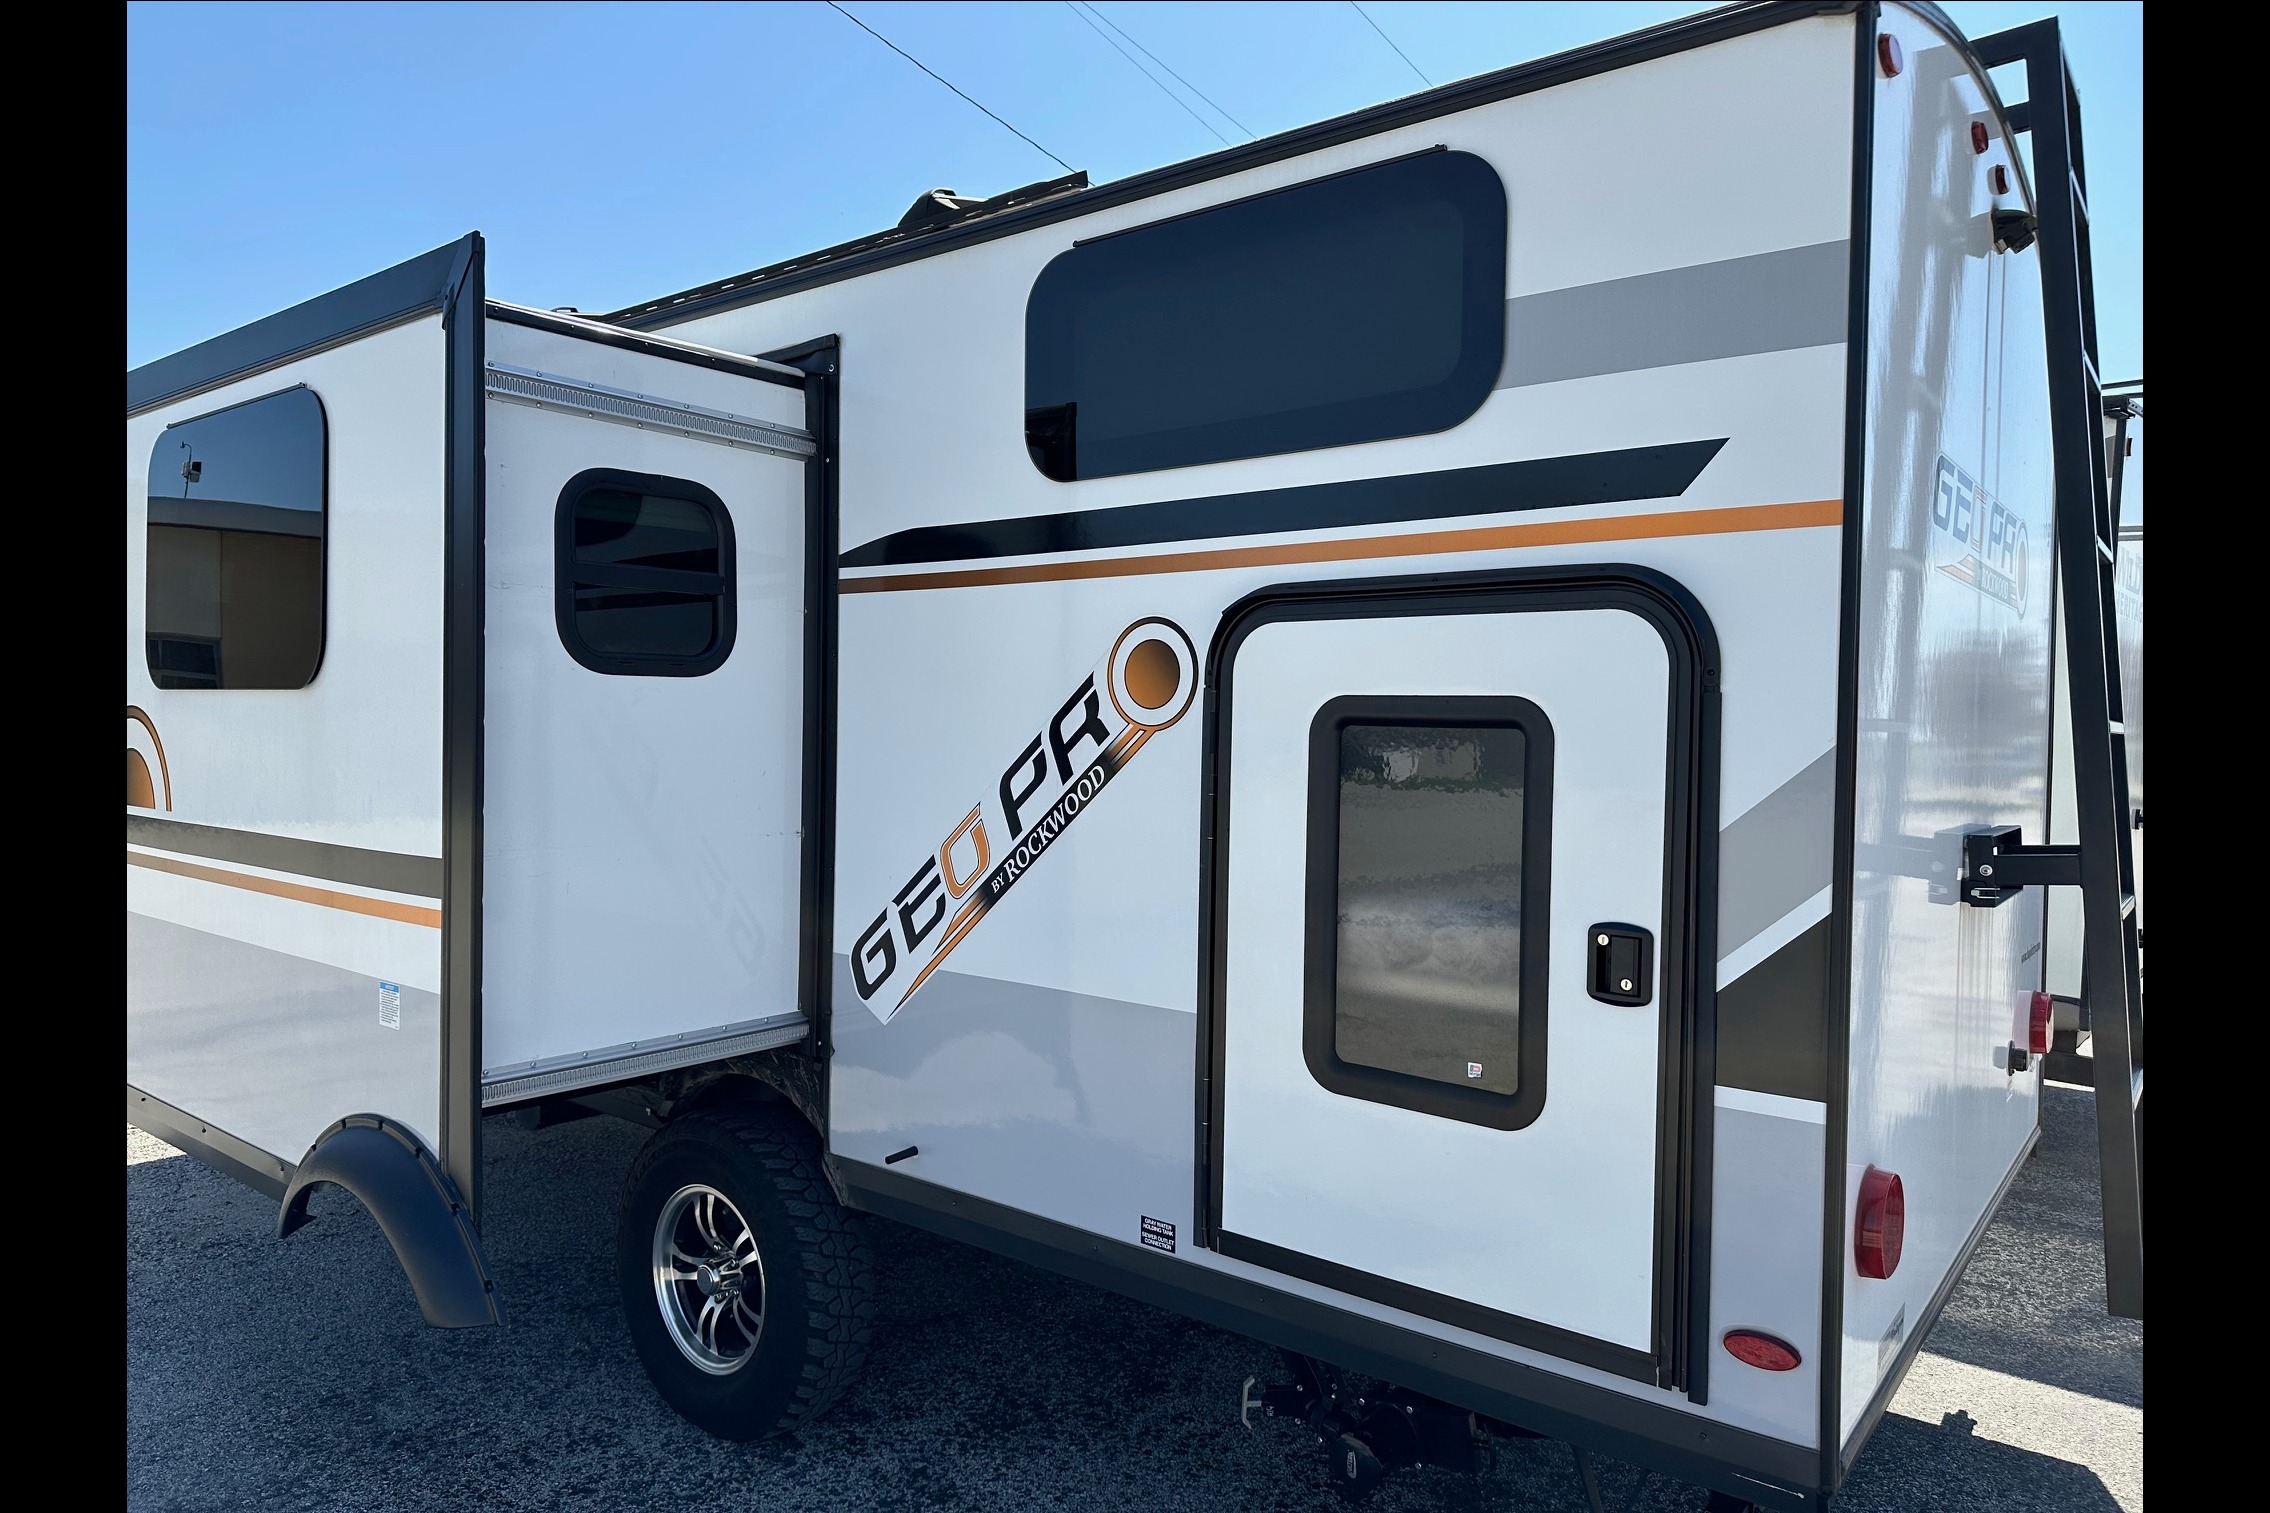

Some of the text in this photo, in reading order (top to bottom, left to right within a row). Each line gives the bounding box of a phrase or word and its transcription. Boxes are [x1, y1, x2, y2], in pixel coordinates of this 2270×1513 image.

[1934, 455, 1986, 553] GEO
[990, 763, 1107, 894] BY ROCKWOOD
[849, 801, 991, 1001] GEO
[1143, 1223, 1162, 1233] HOLDING
[1157, 1222, 1172, 1230] WATER
[1142, 1231, 1174, 1246] SEWER OUTLET
[1144, 1238, 1172, 1250] CONNECTION
